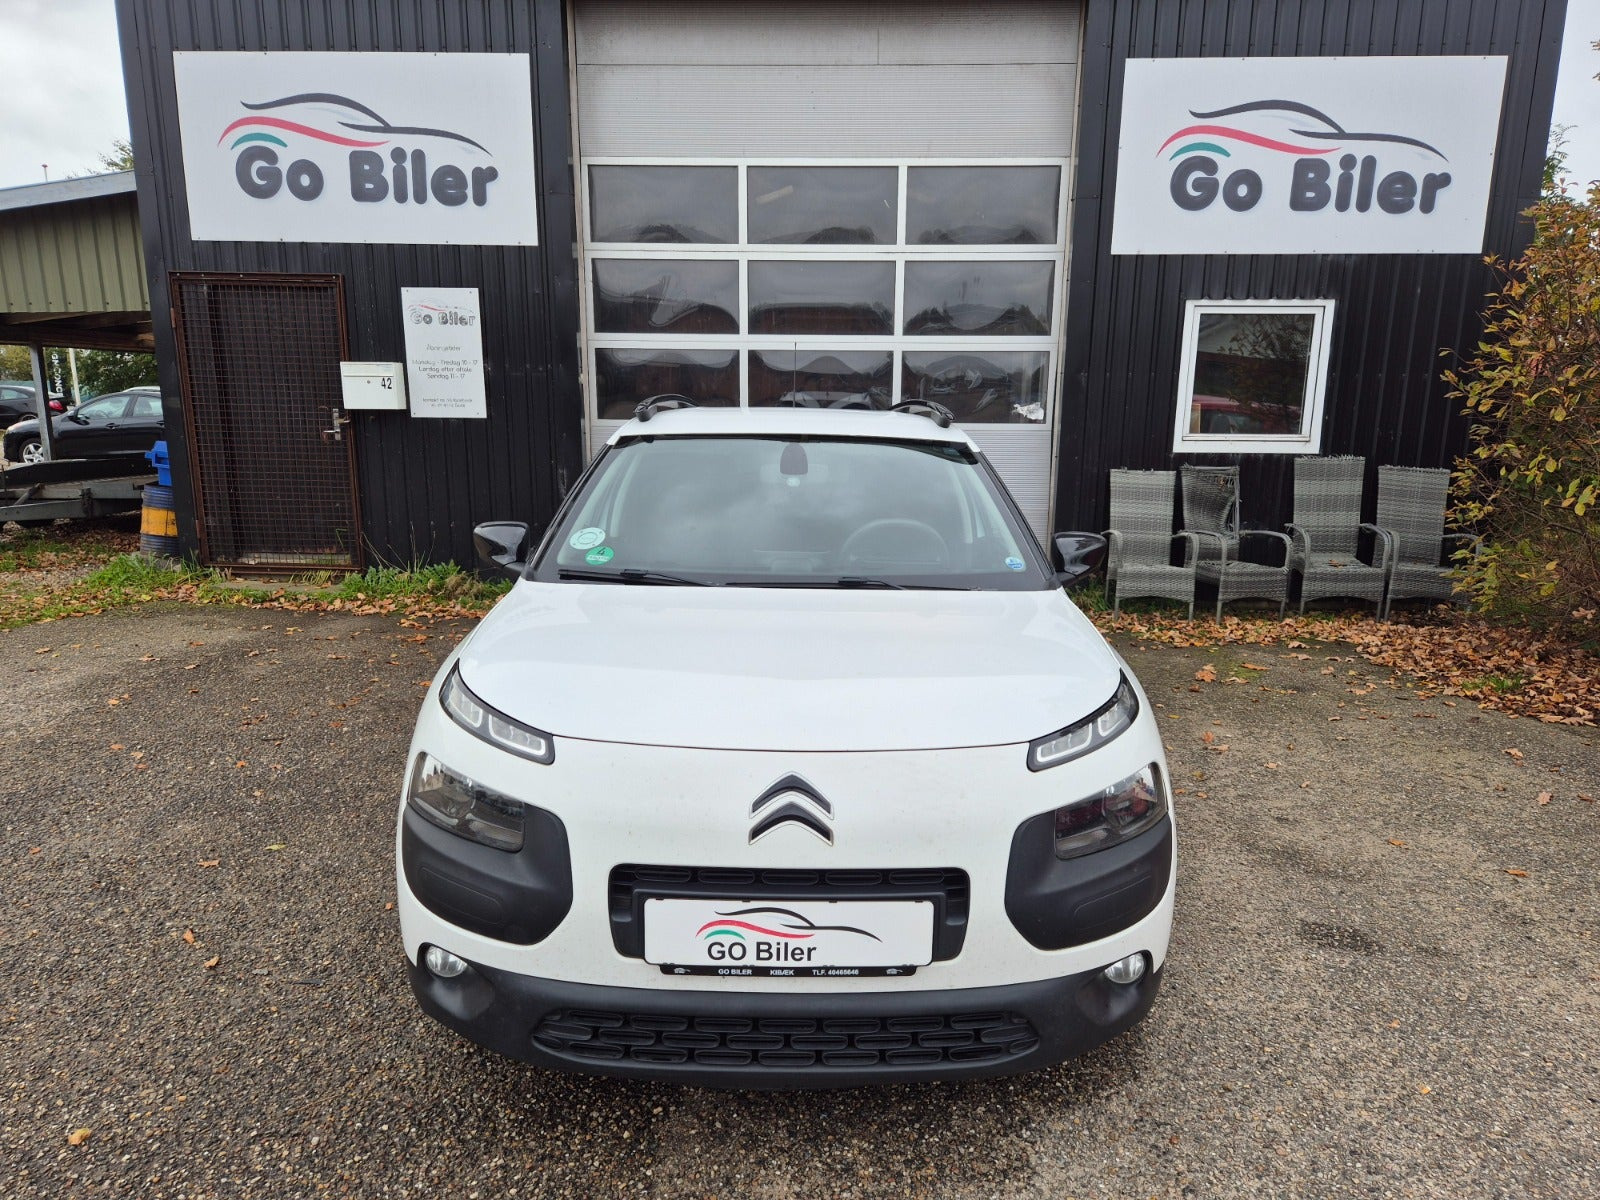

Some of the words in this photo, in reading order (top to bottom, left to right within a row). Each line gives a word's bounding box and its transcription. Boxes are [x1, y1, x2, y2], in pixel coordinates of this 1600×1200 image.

[235, 145, 324, 202] Go
[348, 146, 498, 207] Biler
[1170, 155, 1263, 212] Go
[1289, 153, 1452, 214] Biler
[410, 311, 433, 325] Go
[438, 310, 476, 326] Biler
[381, 377, 392, 389] 42
[707, 941, 747, 961] GO
[755, 941, 817, 961] Biler
